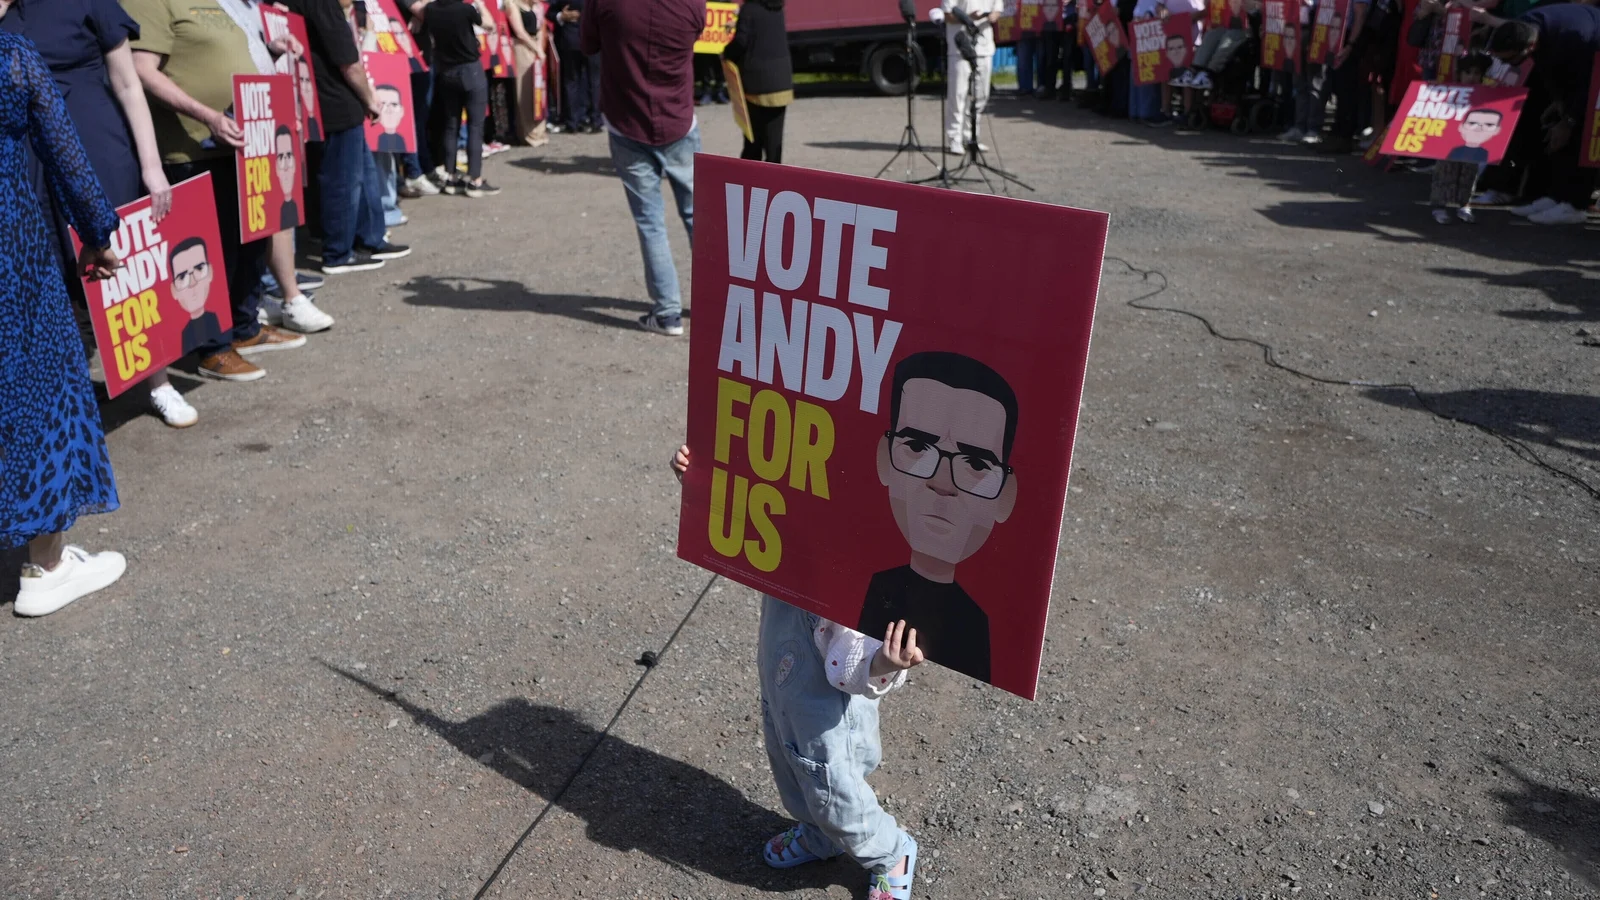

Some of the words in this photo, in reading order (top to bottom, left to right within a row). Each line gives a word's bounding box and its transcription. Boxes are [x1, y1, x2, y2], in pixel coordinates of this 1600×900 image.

[705, 8, 736, 27] OTE
[1134, 21, 1163, 40] VOTE
[1136, 35, 1167, 53] ANDY
[1137, 50, 1160, 67] FOR
[1139, 65, 1155, 82] US
[240, 82, 273, 120] VOTE
[1407, 101, 1472, 121] ANDY
[1416, 84, 1474, 105] VOTE
[243, 119, 276, 158] ANDY
[1393, 133, 1427, 153] US
[1401, 117, 1447, 137] FOR
[245, 156, 271, 195] FOR
[110, 206, 162, 259] OTE
[247, 194, 266, 233] US
[725, 183, 898, 311] VOTE
[101, 241, 169, 309] ANDY
[105, 288, 162, 346] FOR
[113, 333, 152, 381] US
[717, 284, 904, 414] ANDY
[713, 376, 836, 500] FOR
[707, 468, 787, 572] US
